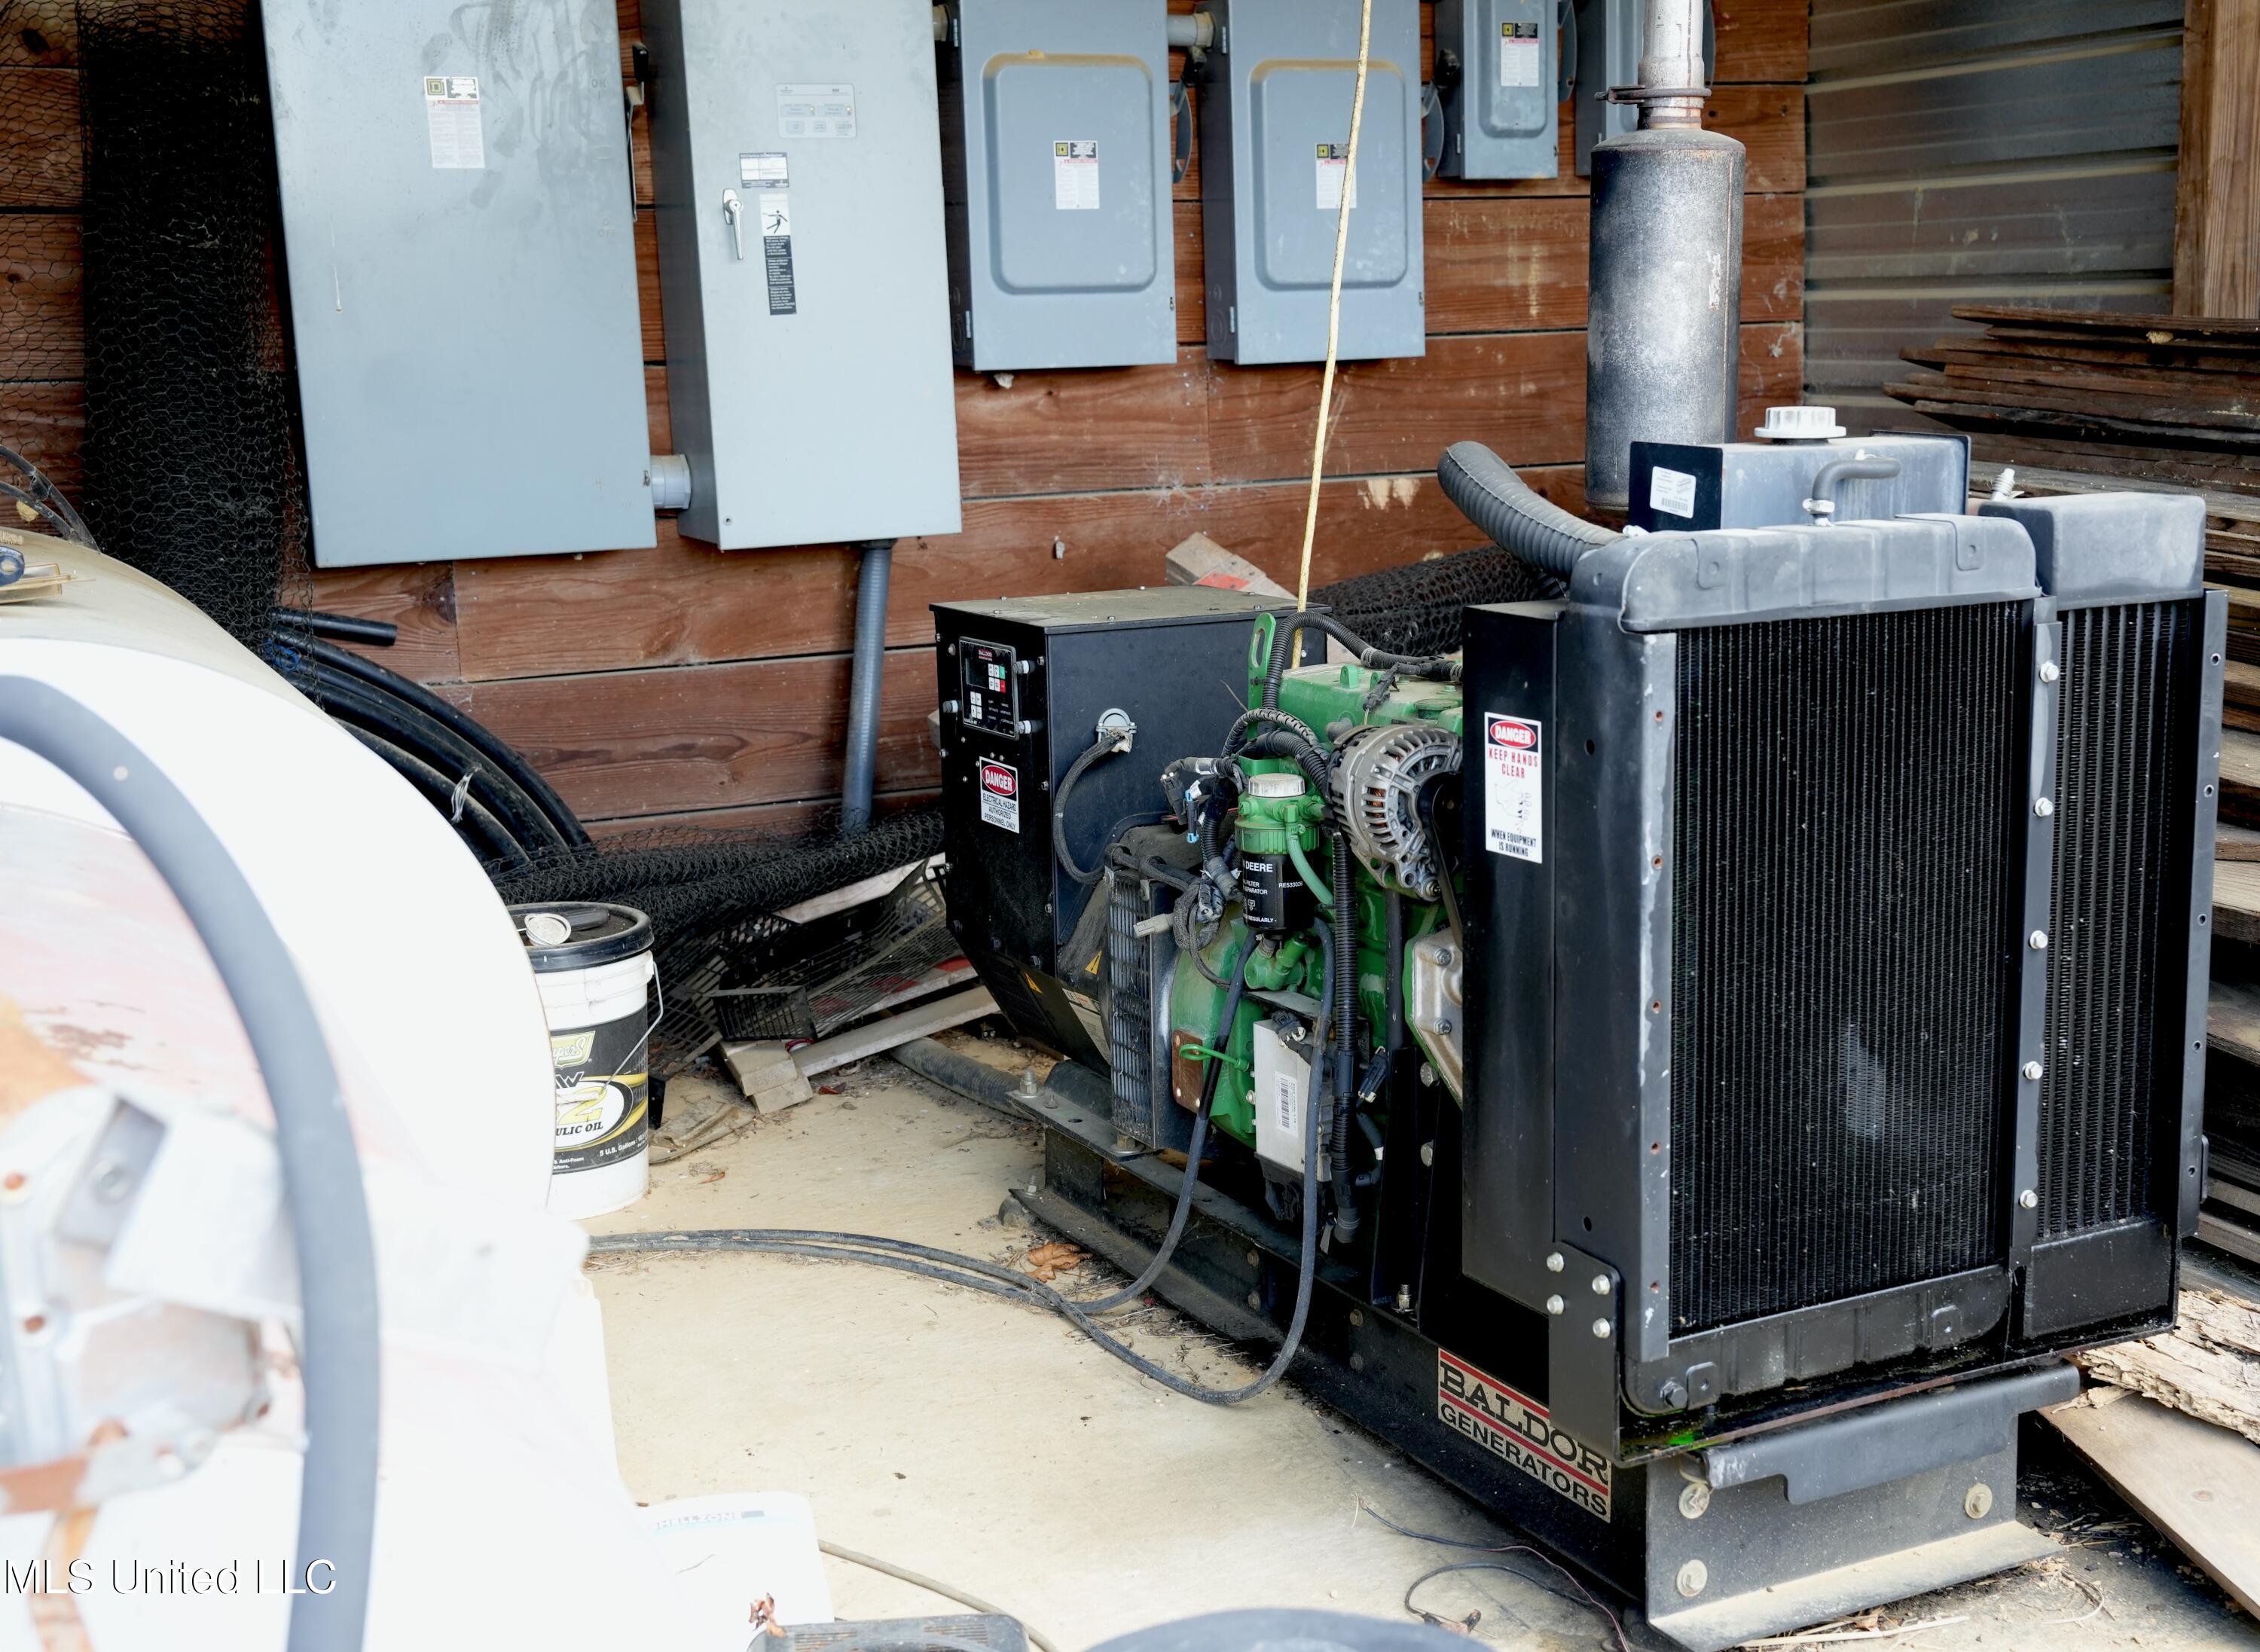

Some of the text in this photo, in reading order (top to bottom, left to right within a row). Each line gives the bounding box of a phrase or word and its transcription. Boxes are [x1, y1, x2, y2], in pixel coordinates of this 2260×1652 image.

[1494, 725, 1532, 745] DANGER
[1489, 747, 1538, 768] KEEP HANDS
[985, 768, 1013, 792] DANGER
[1501, 763, 1526, 779] CLEAR
[982, 792, 1017, 812] ELECTRICAL HAZARD
[984, 813, 1016, 831] PERSONNEL ONLY
[988, 806, 1012, 820] AUTHORIZED
[1491, 829, 1537, 848] WHEN EQUIPMENT
[1498, 841, 1529, 857] IS RUNNING
[1245, 861, 1273, 872] DEERE
[1248, 913, 1274, 923] REGULARLY
[555, 1121, 603, 1136] ULIC OIL
[605, 1147, 618, 1156] U.S.
[618, 1140, 637, 1151] Gallons
[1440, 1360, 1609, 1486] BALDOR
[1440, 1402, 1608, 1517] GENERATORS
